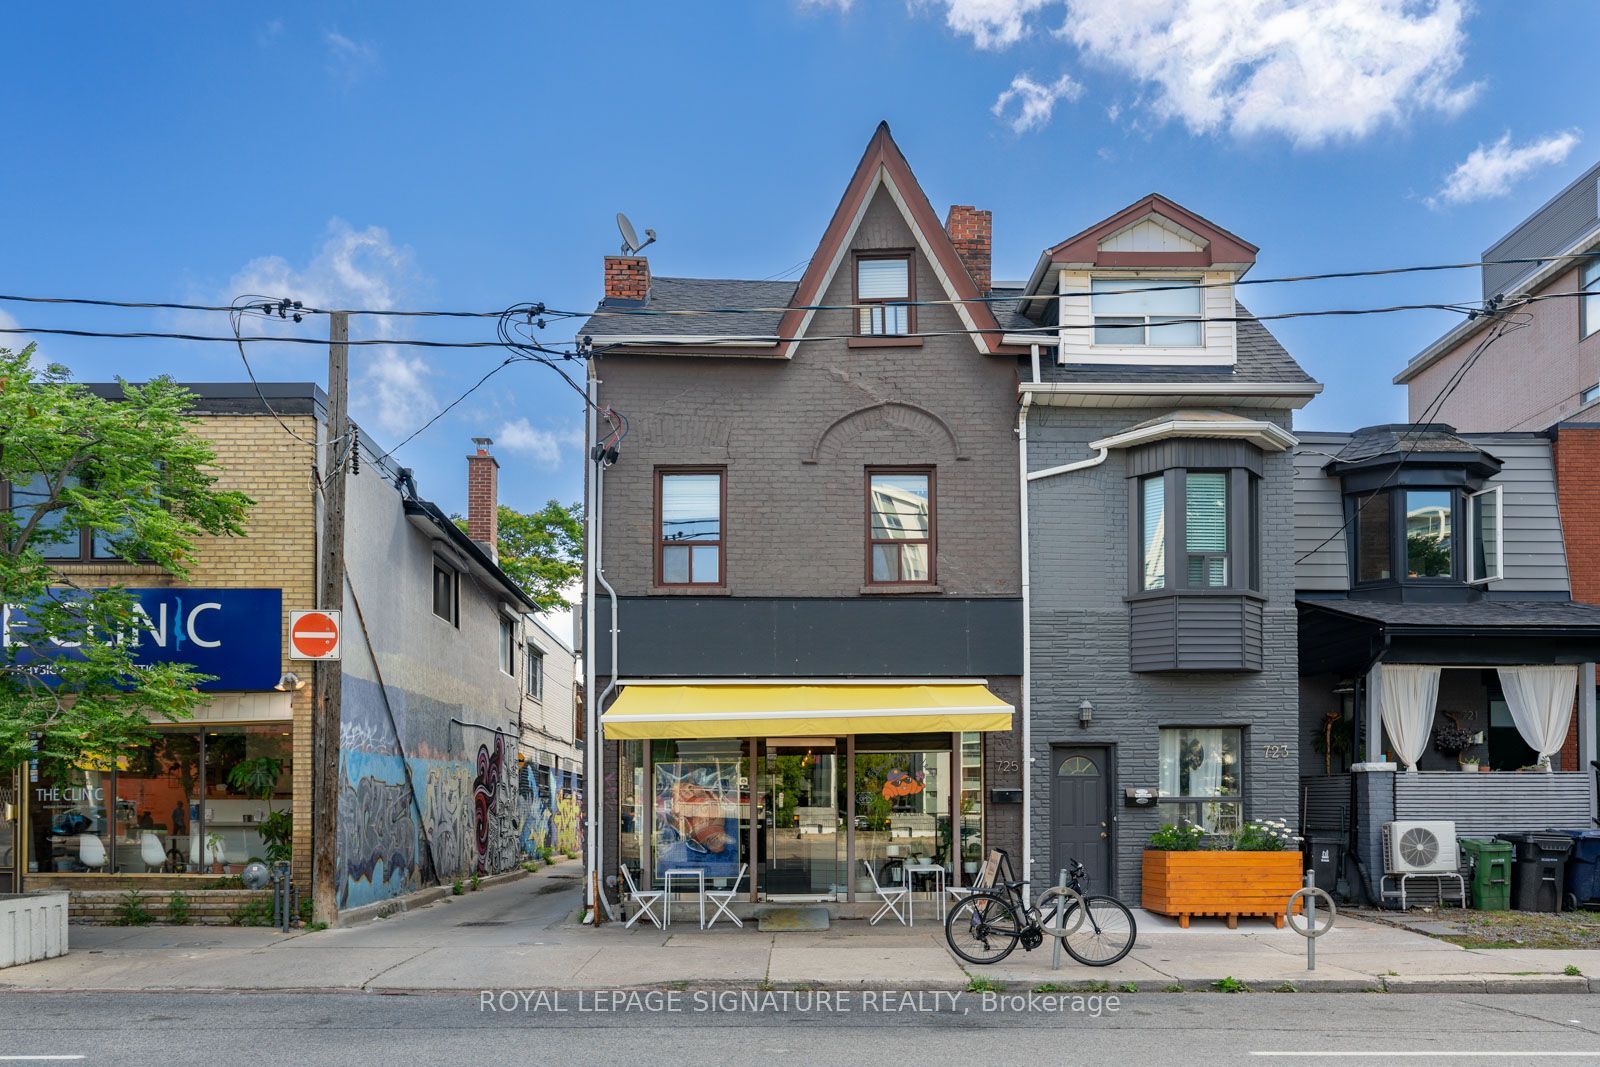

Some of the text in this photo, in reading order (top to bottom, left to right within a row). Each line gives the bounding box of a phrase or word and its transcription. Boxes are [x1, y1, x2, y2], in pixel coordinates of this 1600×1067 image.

[1263, 744, 1289, 759] 723
[995, 760, 1019, 772] 725
[35, 788, 60, 801] THE
